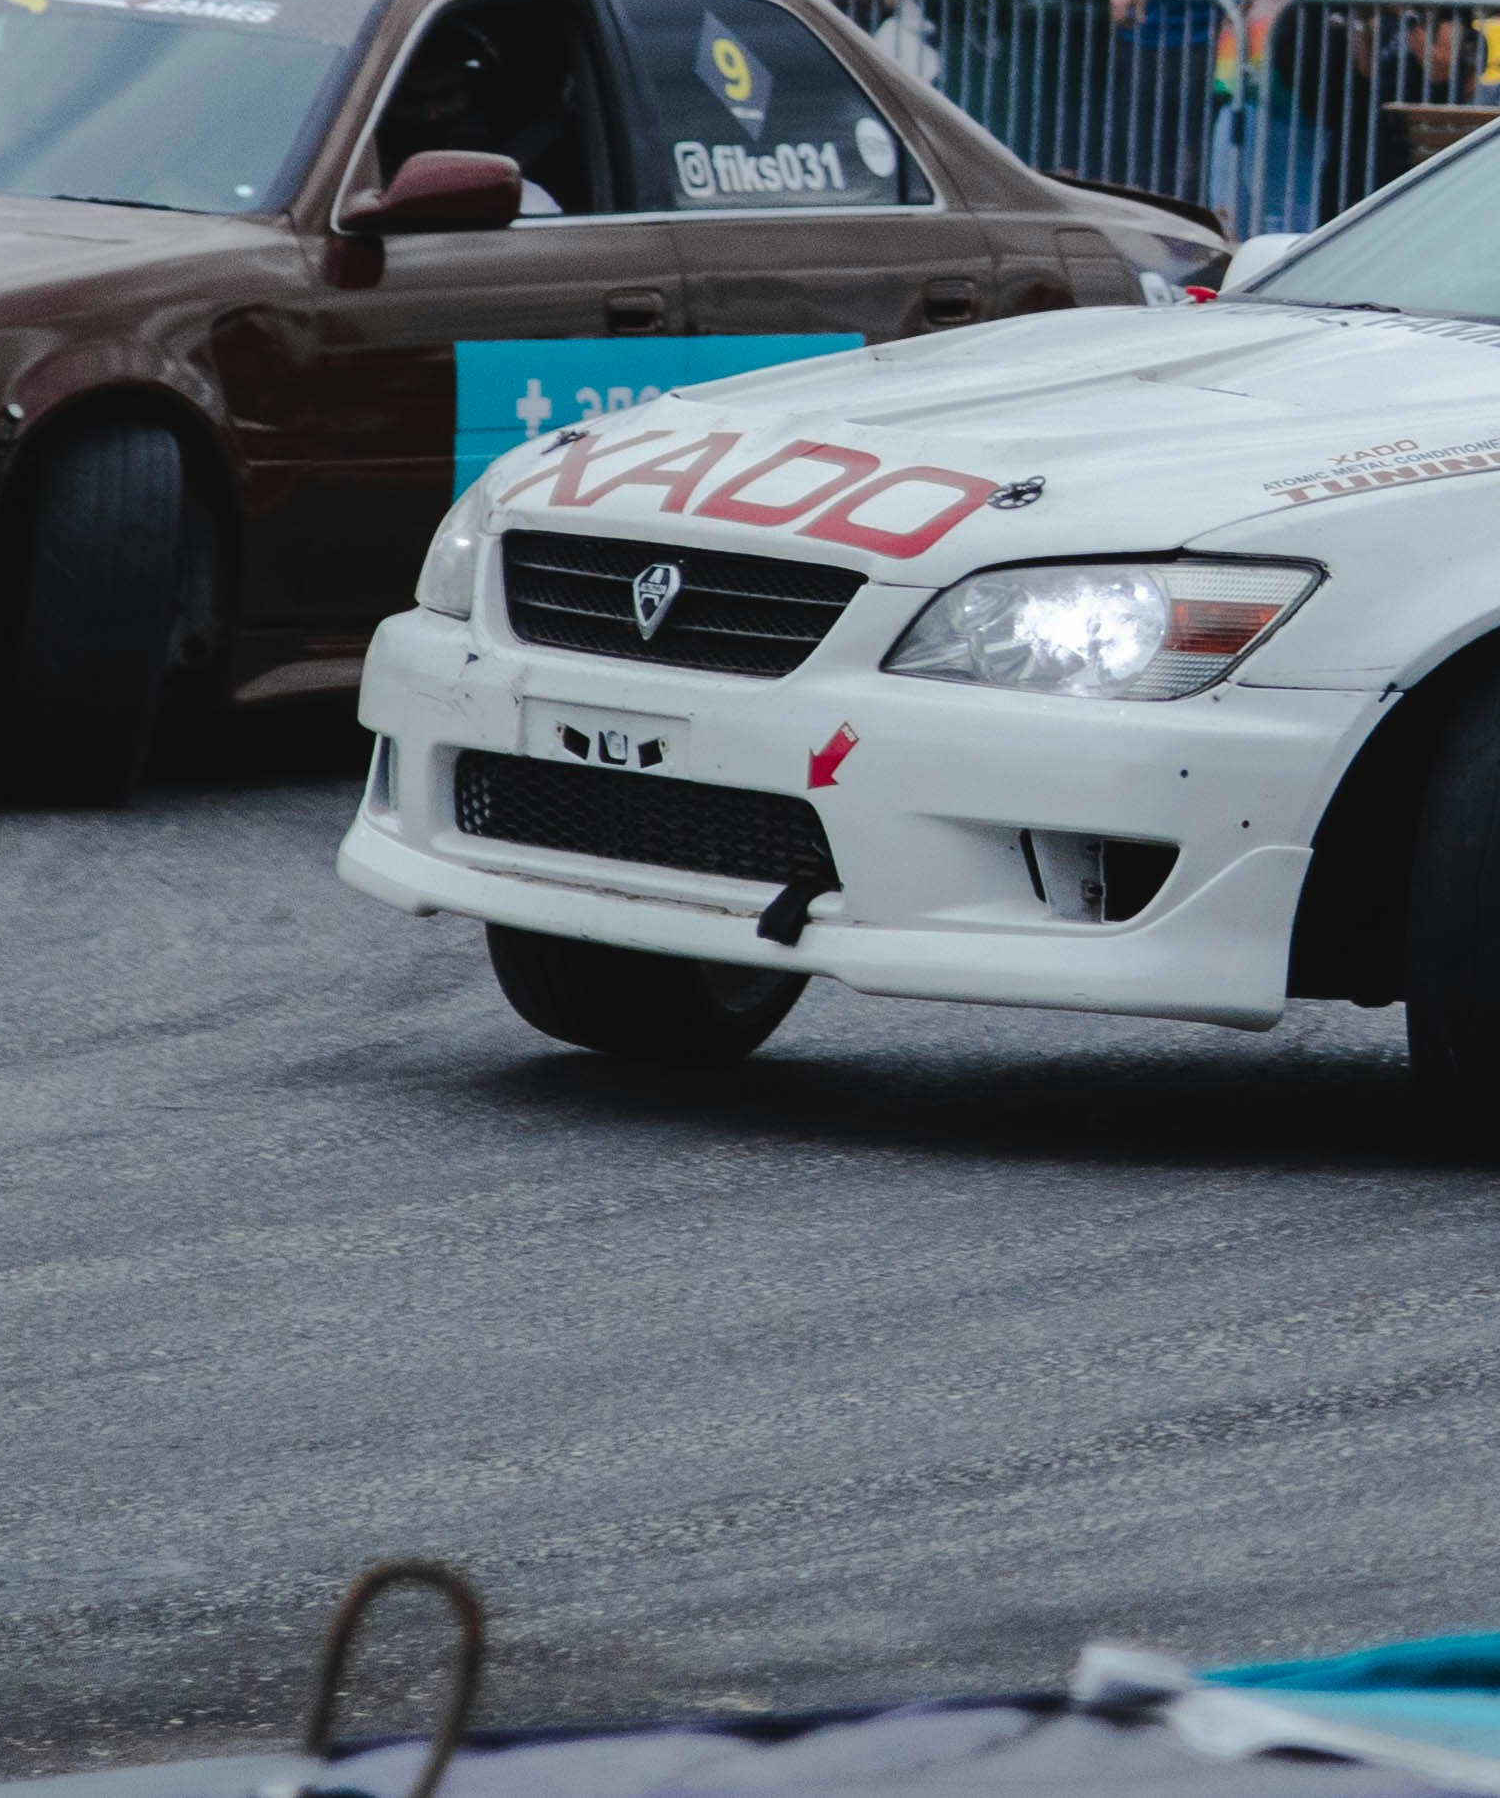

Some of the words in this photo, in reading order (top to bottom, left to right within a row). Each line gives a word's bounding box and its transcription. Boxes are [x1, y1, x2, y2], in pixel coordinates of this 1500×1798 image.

[711, 38, 752, 101] 9
[673, 141, 845, 199] @fiks031
[1262, 470, 1329, 492] ATOMIC
[1331, 458, 1393, 478] METAL
[1327, 438, 1420, 466] XADO
[496, 430, 1002, 560] XADO
